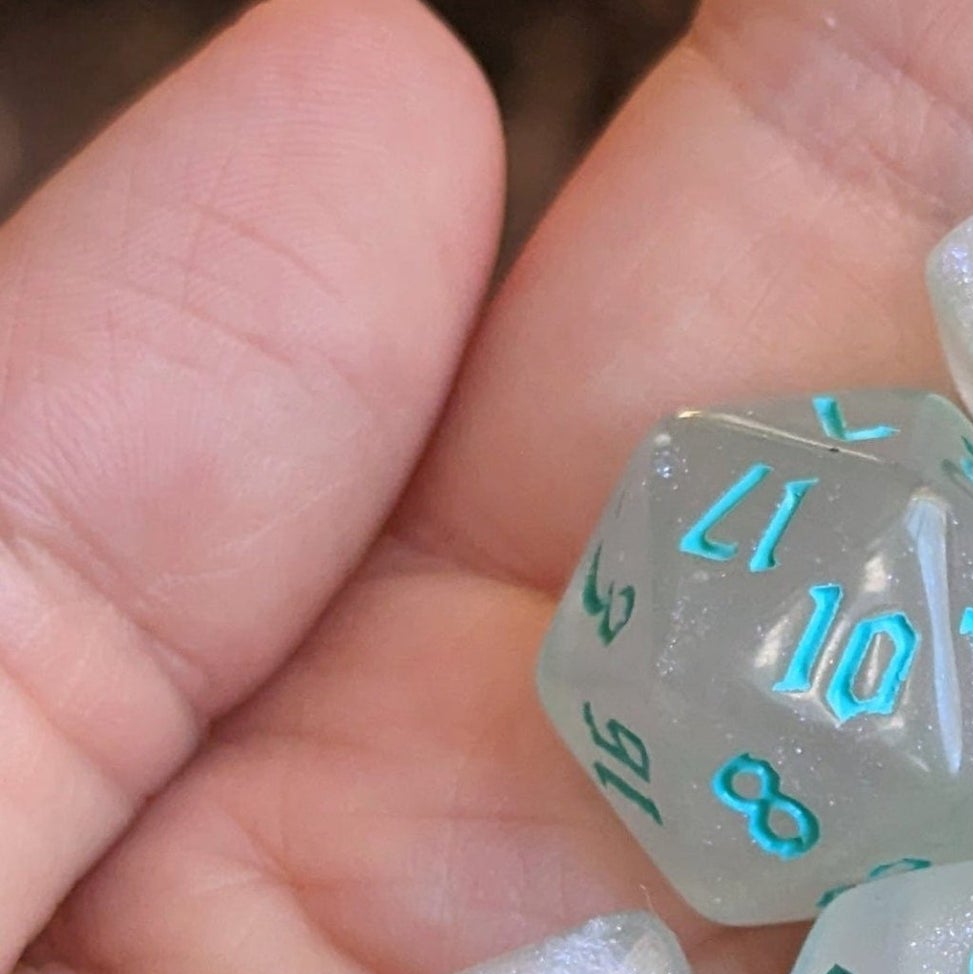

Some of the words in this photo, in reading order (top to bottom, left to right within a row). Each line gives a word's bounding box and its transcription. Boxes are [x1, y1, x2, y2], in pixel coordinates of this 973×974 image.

[679, 462, 820, 573] 17
[772, 584, 918, 723] 10
[712, 752, 820, 857] 8
